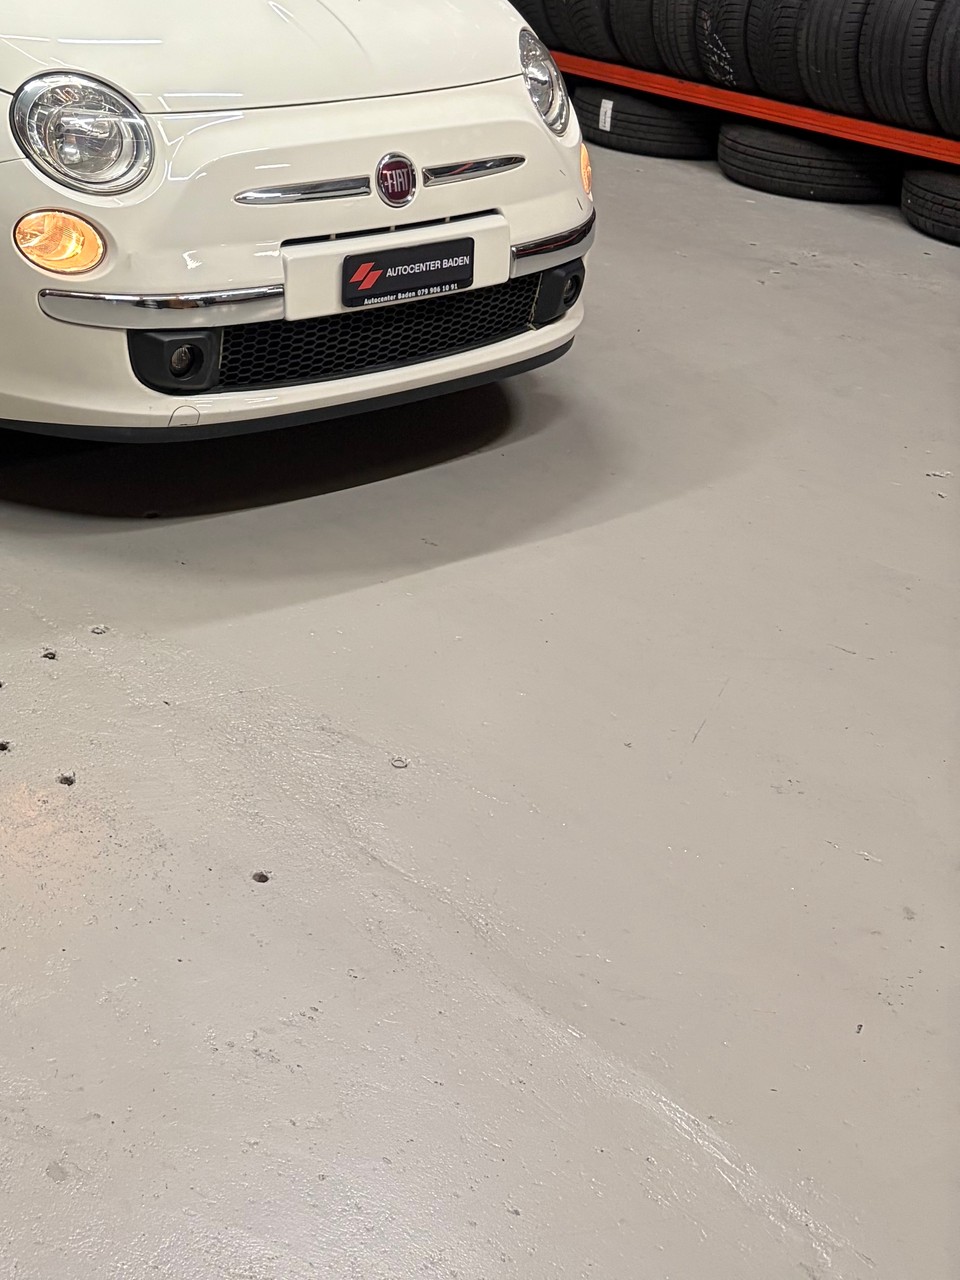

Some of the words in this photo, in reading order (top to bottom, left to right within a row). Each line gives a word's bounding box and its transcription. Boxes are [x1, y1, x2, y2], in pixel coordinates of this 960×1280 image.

[382, 168, 409, 193] FIAT
[386, 260, 441, 277] AUTOCENTER
[442, 255, 470, 269] BADEN
[364, 294, 397, 305] Autocenter
[397, 291, 416, 300] Baden
[417, 288, 429, 296] 079
[430, 286, 441, 294] 906
